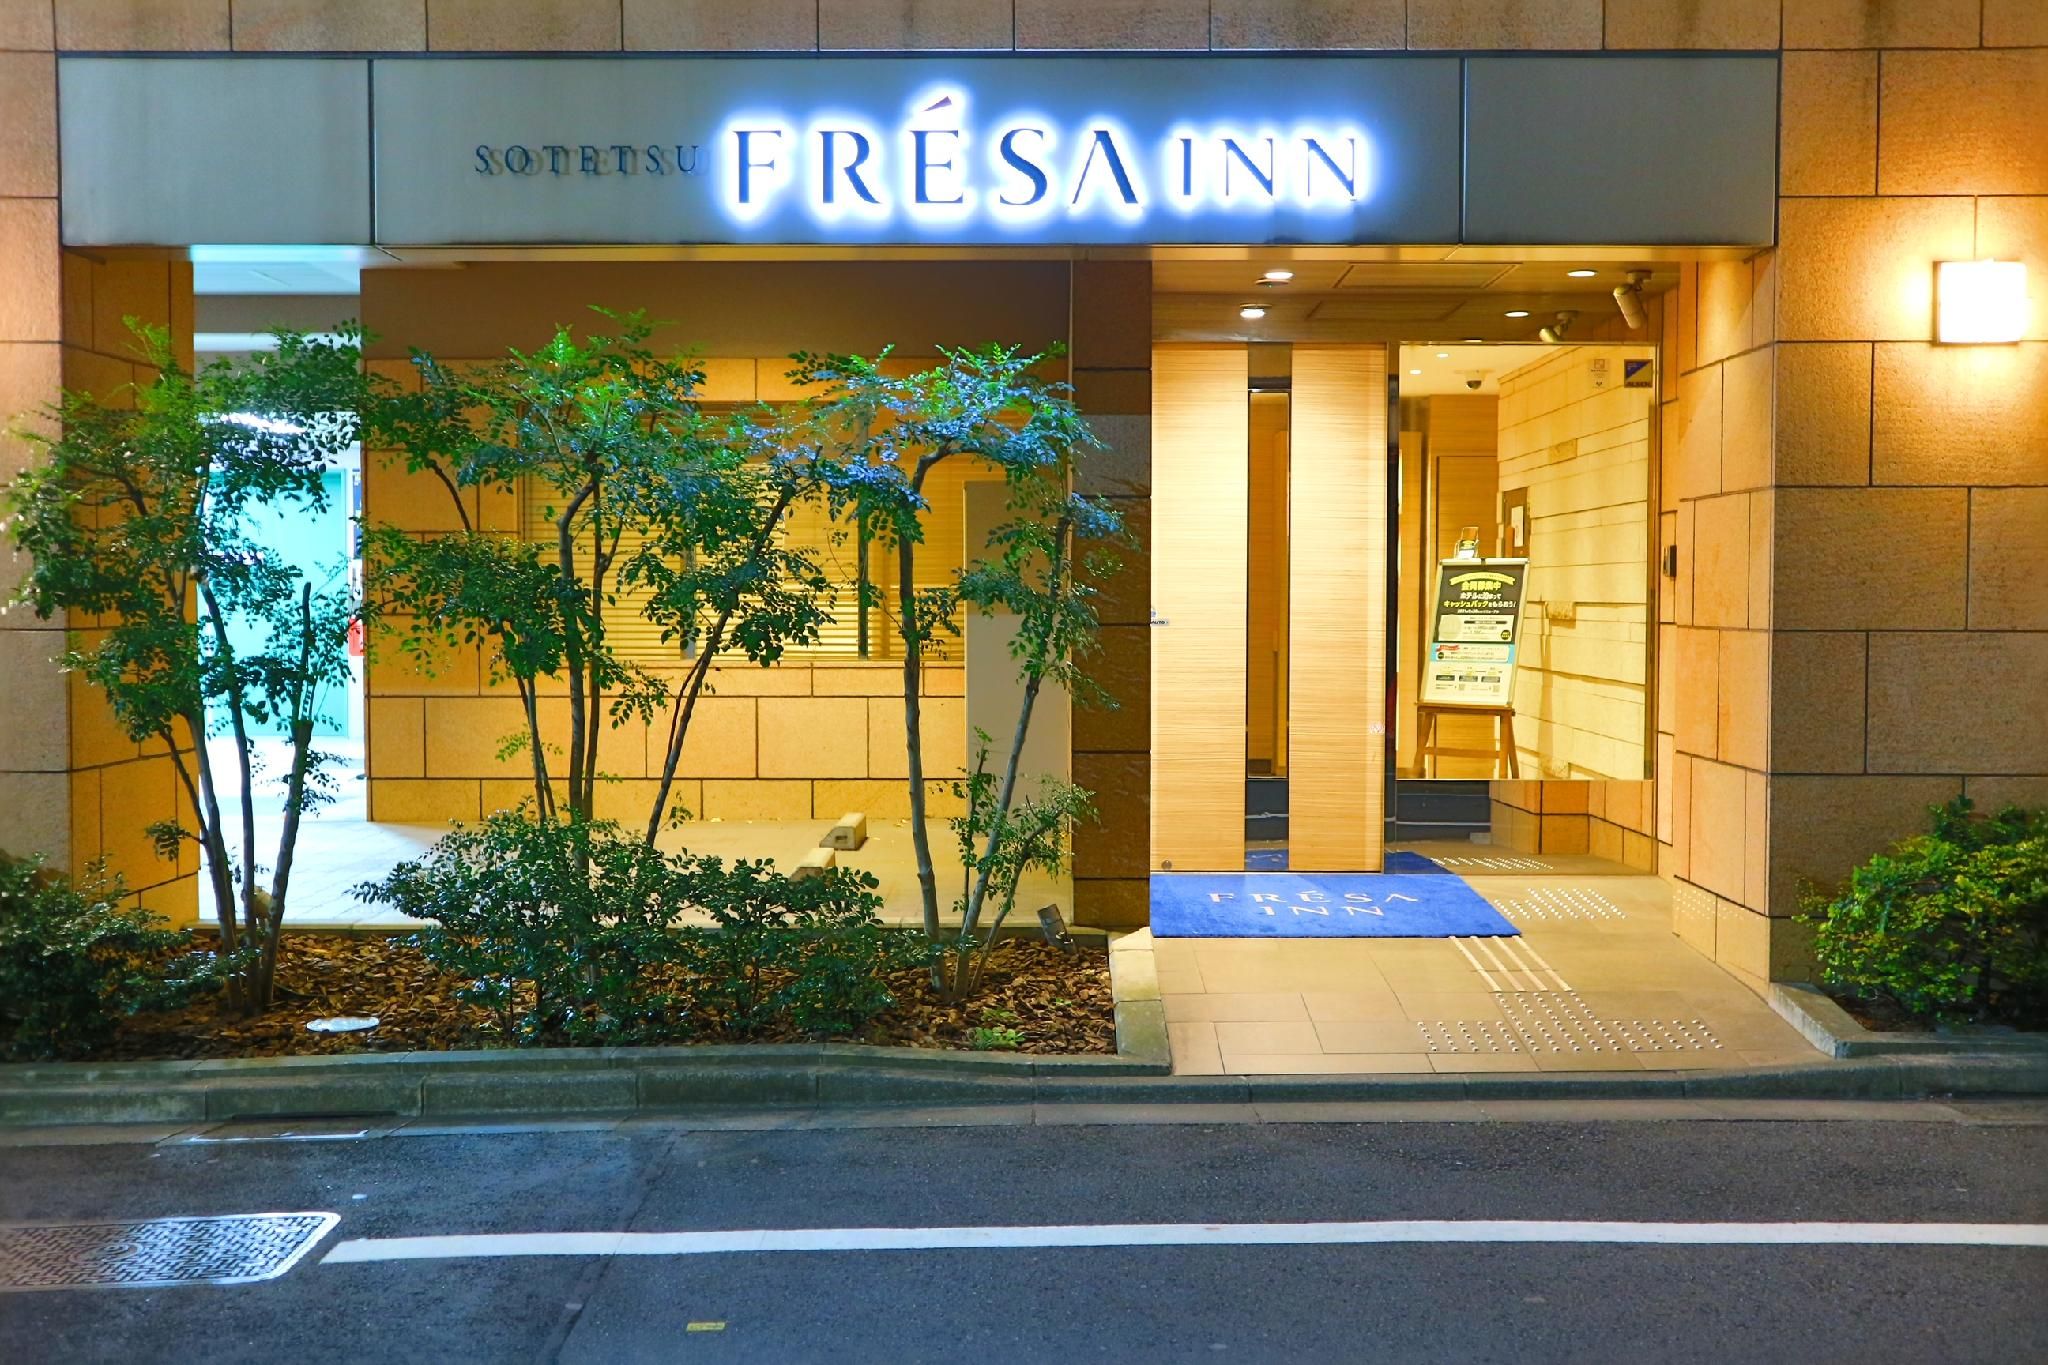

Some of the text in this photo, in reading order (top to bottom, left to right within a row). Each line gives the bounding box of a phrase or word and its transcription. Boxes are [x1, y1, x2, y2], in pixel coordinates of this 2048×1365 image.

[474, 95, 1358, 206] SOTETSU FRÉSA INN
[1208, 890, 1418, 903] FRÉSA
[1263, 905, 1385, 917] INN
